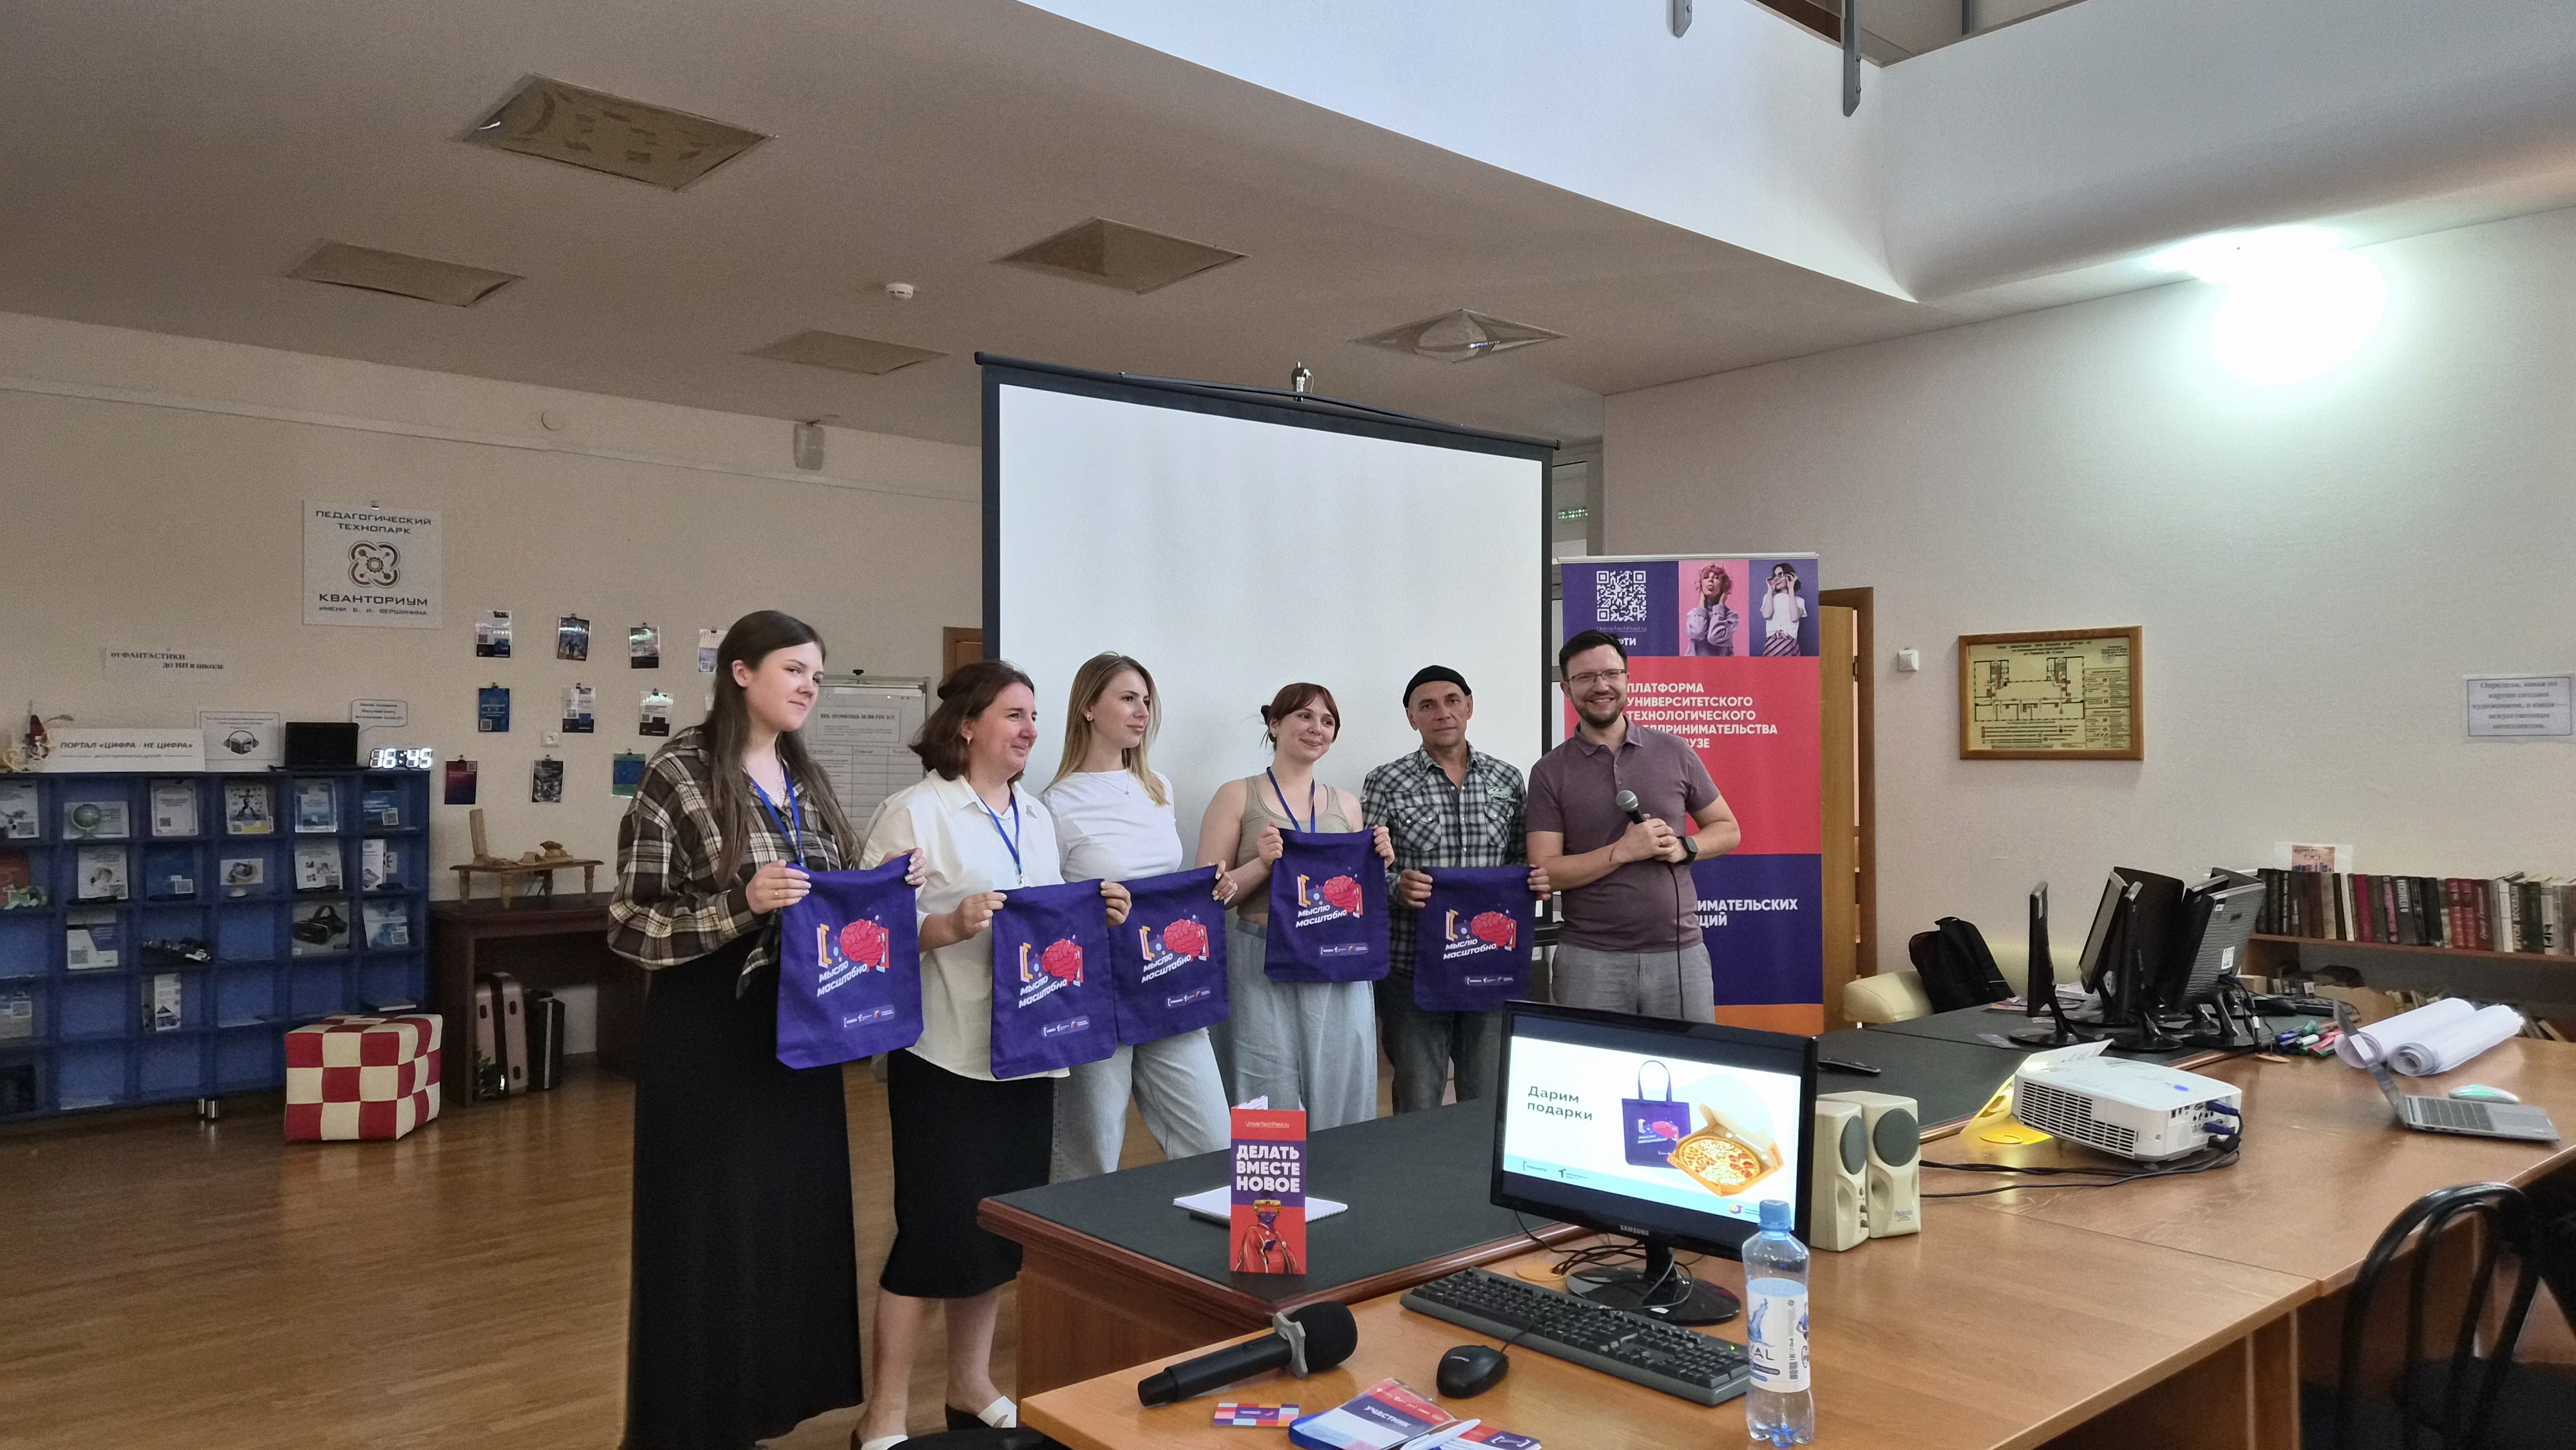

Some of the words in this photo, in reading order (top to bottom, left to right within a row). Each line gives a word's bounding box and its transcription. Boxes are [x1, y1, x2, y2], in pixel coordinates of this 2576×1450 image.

[316, 511, 431, 525] ПЕДАГОГИЧЕСКИЙ
[337, 522, 411, 534] ТЕХНОПАРК
[319, 593, 428, 606] КВАНТОРИУМ
[1626, 683, 1705, 693] ПЛАТФОРМА
[1626, 696, 1753, 707] УНИВЕРСИТЕТСКОГО
[1625, 710, 1756, 720] ТЕХНОЛОГИЧЕСКОГО
[369, 748, 432, 769] 16:45
[1297, 904, 1331, 918] мыслю
[1697, 898, 1799, 912] ИМАТЕЛЬСКИХ
[1295, 909, 1347, 928] масштабно
[1443, 943, 1497, 960] масштабно
[1444, 938, 1478, 951] мыслю
[1141, 954, 1191, 984] масштабно
[1142, 952, 1173, 973] мыслю
[817, 963, 868, 997] масштабно
[819, 960, 849, 983] мыслю
[1018, 978, 1068, 1009] масштабно
[1019, 975, 1049, 996] мыслю
[1528, 1086, 1579, 1104] Дарим
[1528, 1102, 1592, 1121] подарки
[1236, 1145, 1300, 1160] ДЕЛАТЬ
[1236, 1160, 1300, 1176] ВМЕСТЕ
[1236, 1176, 1300, 1193] НОВОЕ
[1620, 1225, 1649, 1236] SAMSUNG
[1363, 1404, 1412, 1428] УЧАСТНИК
